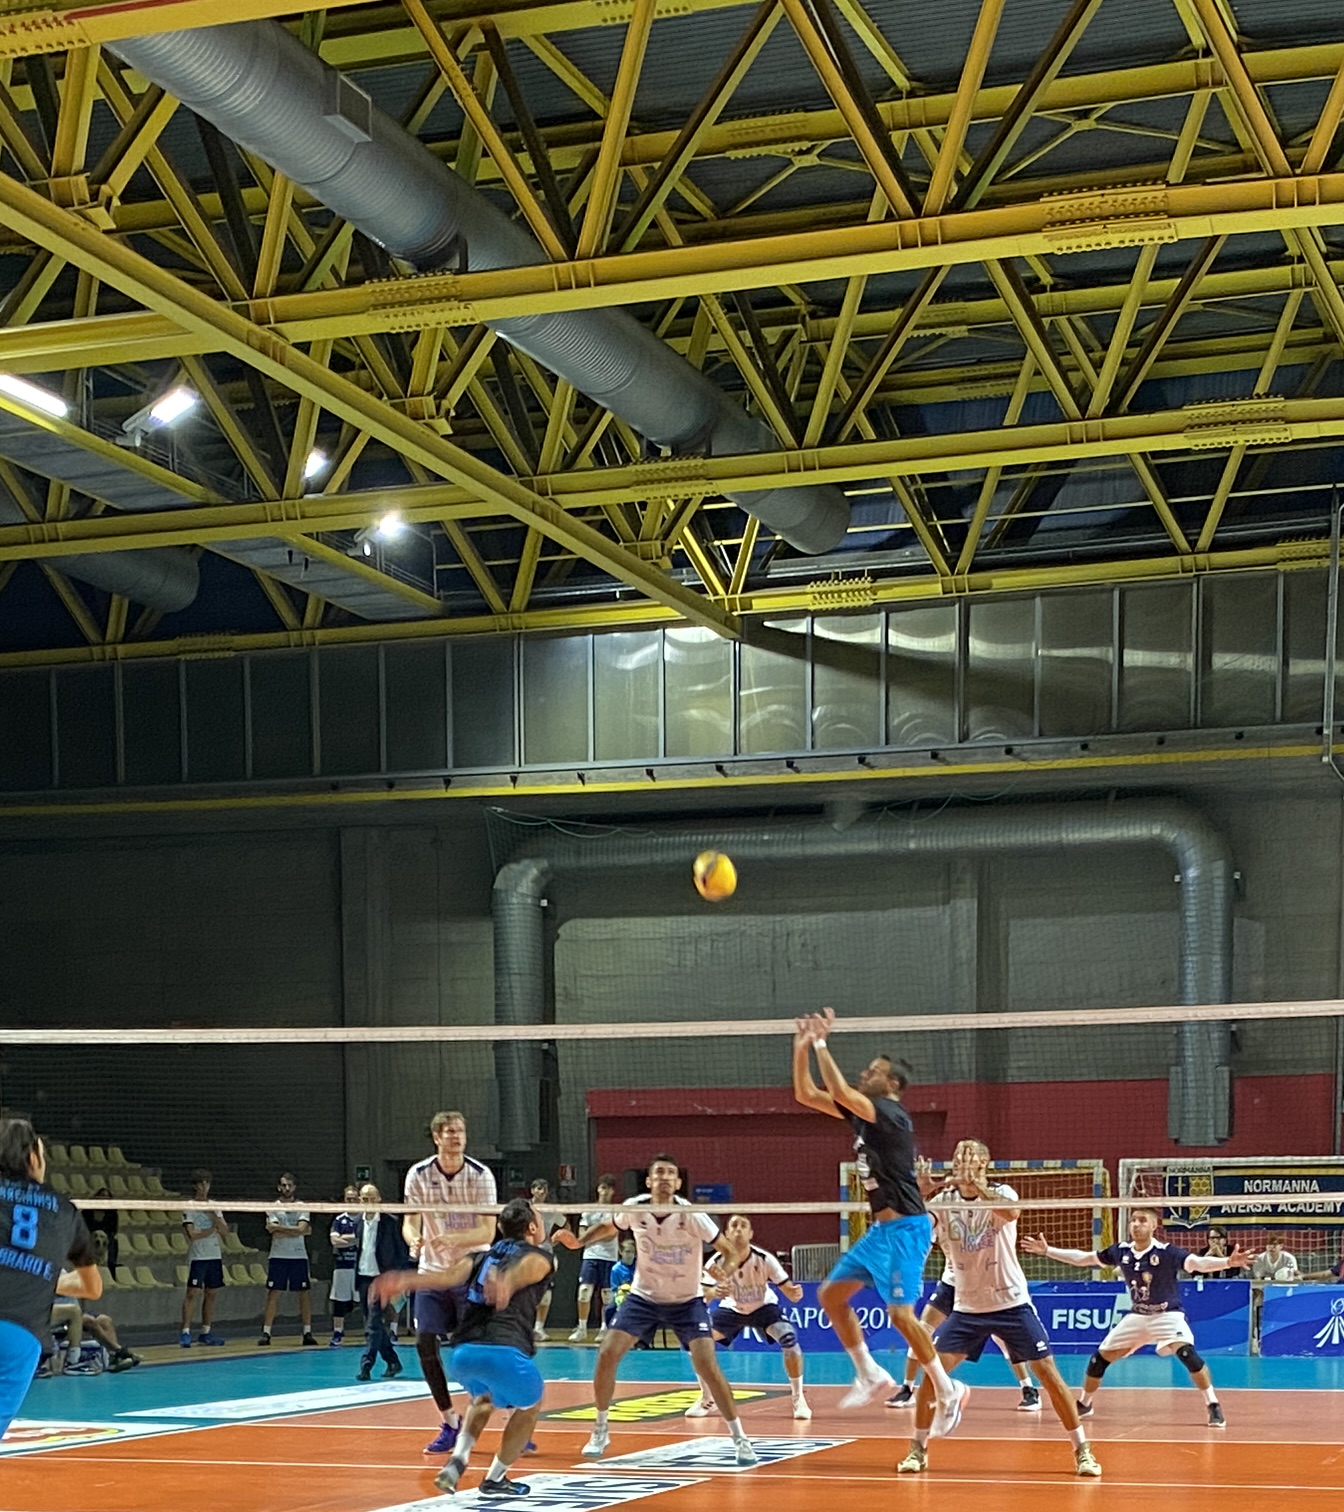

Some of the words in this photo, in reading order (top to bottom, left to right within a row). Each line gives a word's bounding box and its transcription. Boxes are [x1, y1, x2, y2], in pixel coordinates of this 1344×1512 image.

[1243, 1179, 1320, 1193] NORMANNA
[1221, 1202, 1272, 1214] AVERSA
[1277, 1201, 1343, 1213] ACADEMY
[11, 1203, 39, 1250] 8
[782, 1308, 832, 1329] APO
[856, 1307, 891, 1329] 201
[1052, 1308, 1112, 1330] FISU
